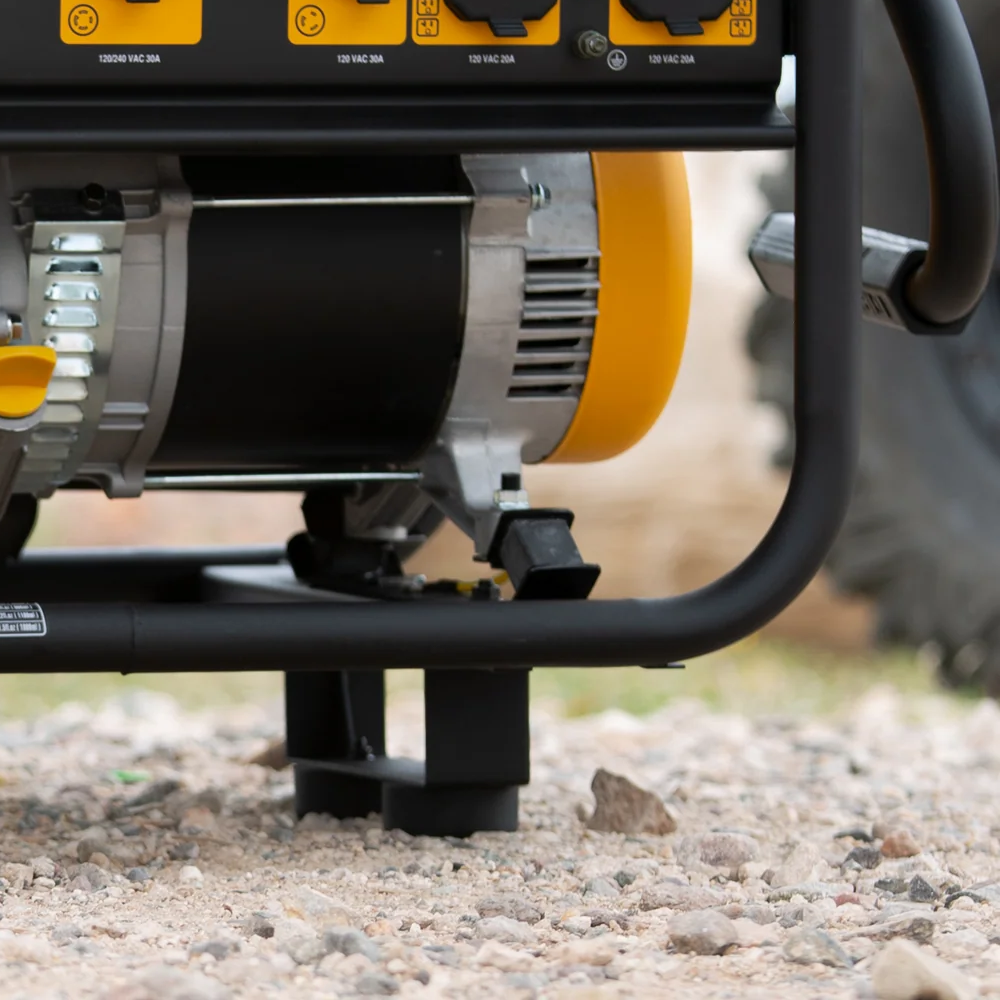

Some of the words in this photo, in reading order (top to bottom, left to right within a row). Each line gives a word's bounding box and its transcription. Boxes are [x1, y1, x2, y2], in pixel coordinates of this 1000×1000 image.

[99, 54, 127, 63] 120/240
[128, 54, 144, 63] VAC
[145, 54, 161, 63] 30A
[337, 54, 349, 64] 120
[351, 54, 368, 64] VAC
[369, 54, 384, 64] 30A
[468, 55, 481, 64] 120
[483, 55, 500, 64] VAC
[500, 55, 515, 64] 20A
[649, 55, 661, 64] 120
[662, 55, 678, 64] VAC
[679, 55, 695, 64] 20A
